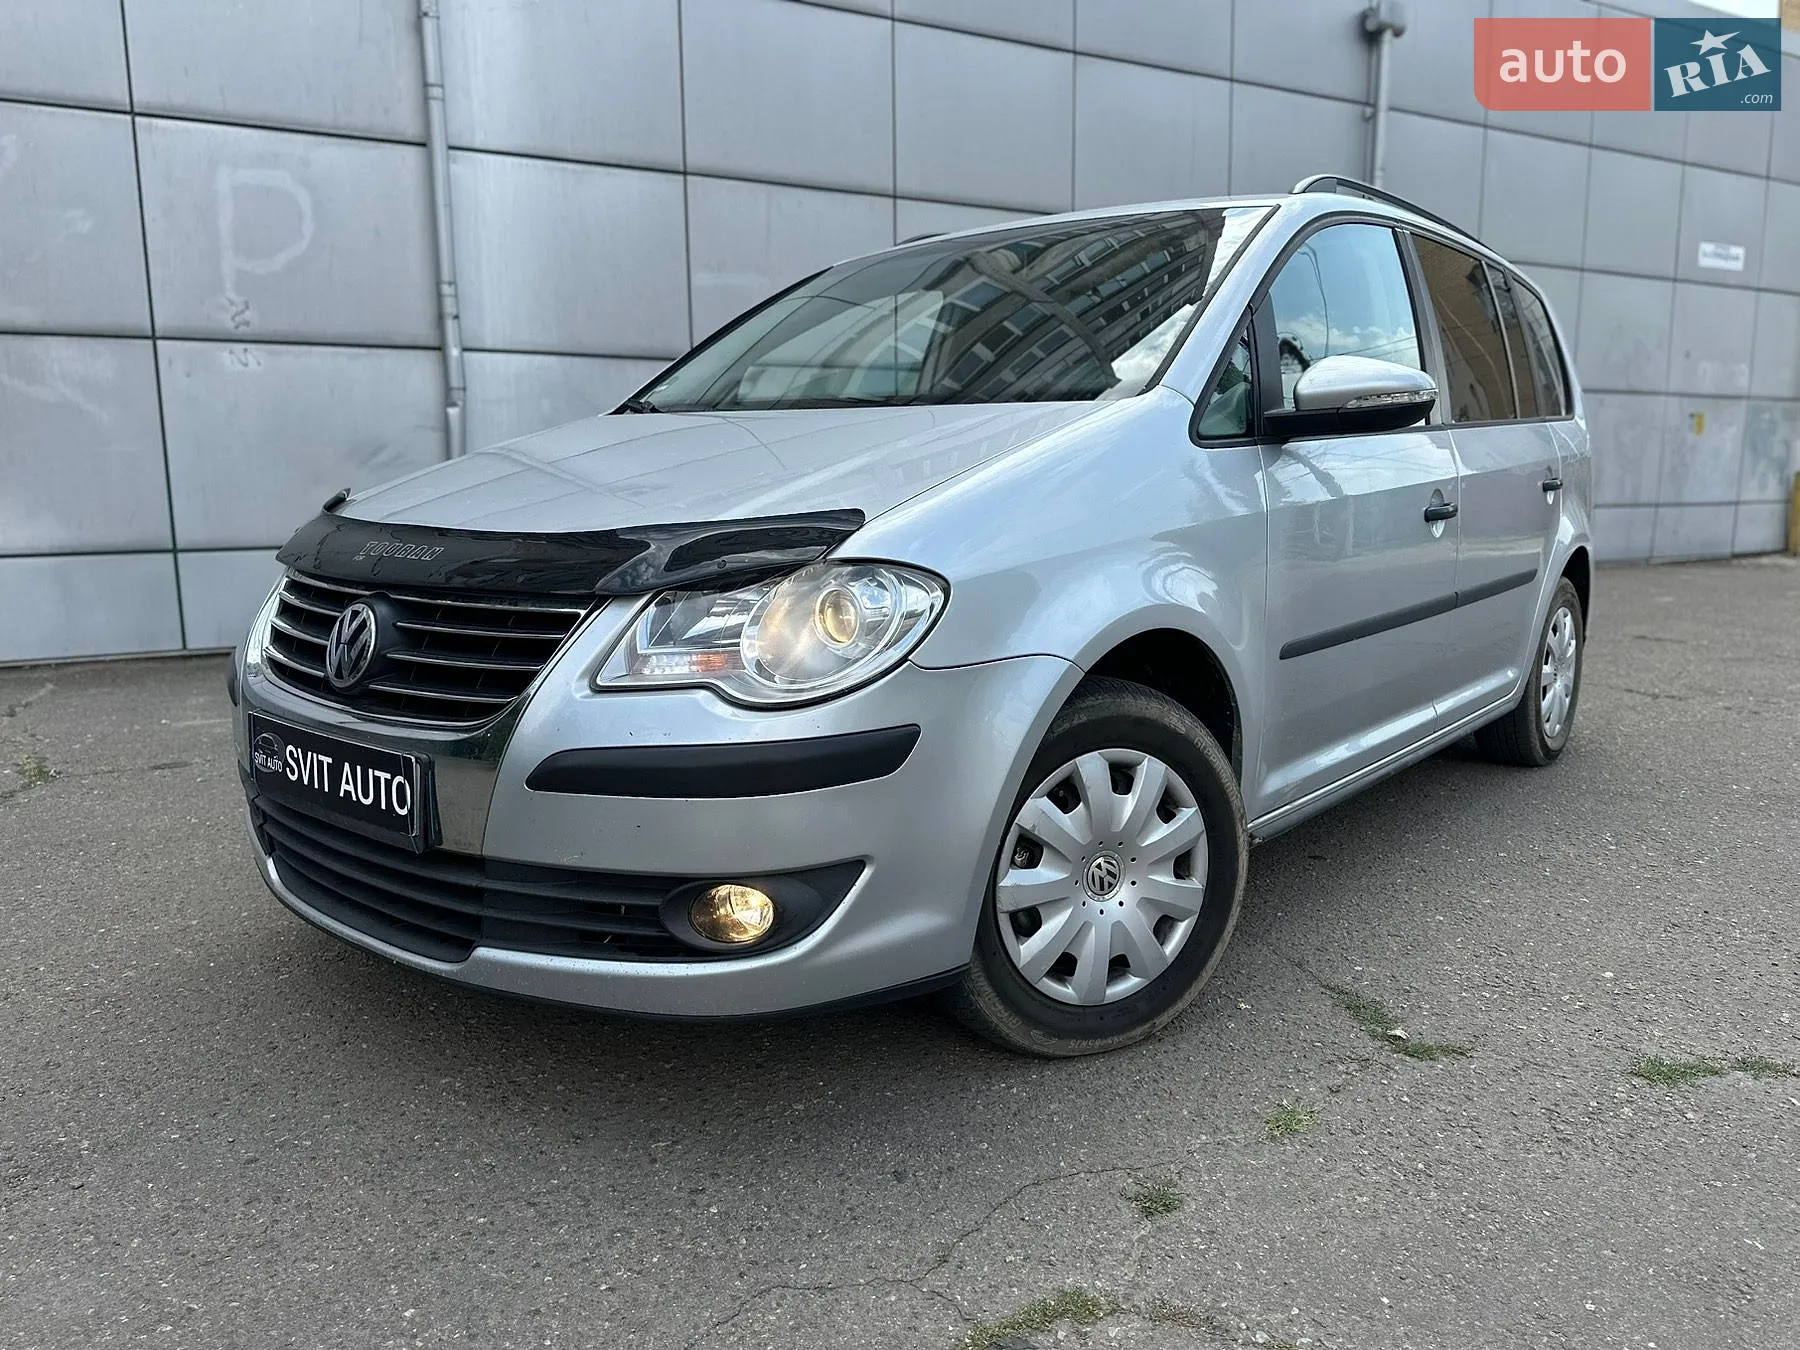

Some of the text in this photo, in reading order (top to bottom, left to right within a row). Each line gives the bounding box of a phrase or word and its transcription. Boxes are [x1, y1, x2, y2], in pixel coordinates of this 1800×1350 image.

[254, 751, 283, 773] SVIT AUTO
[286, 744, 411, 816] SVIT AUTO
